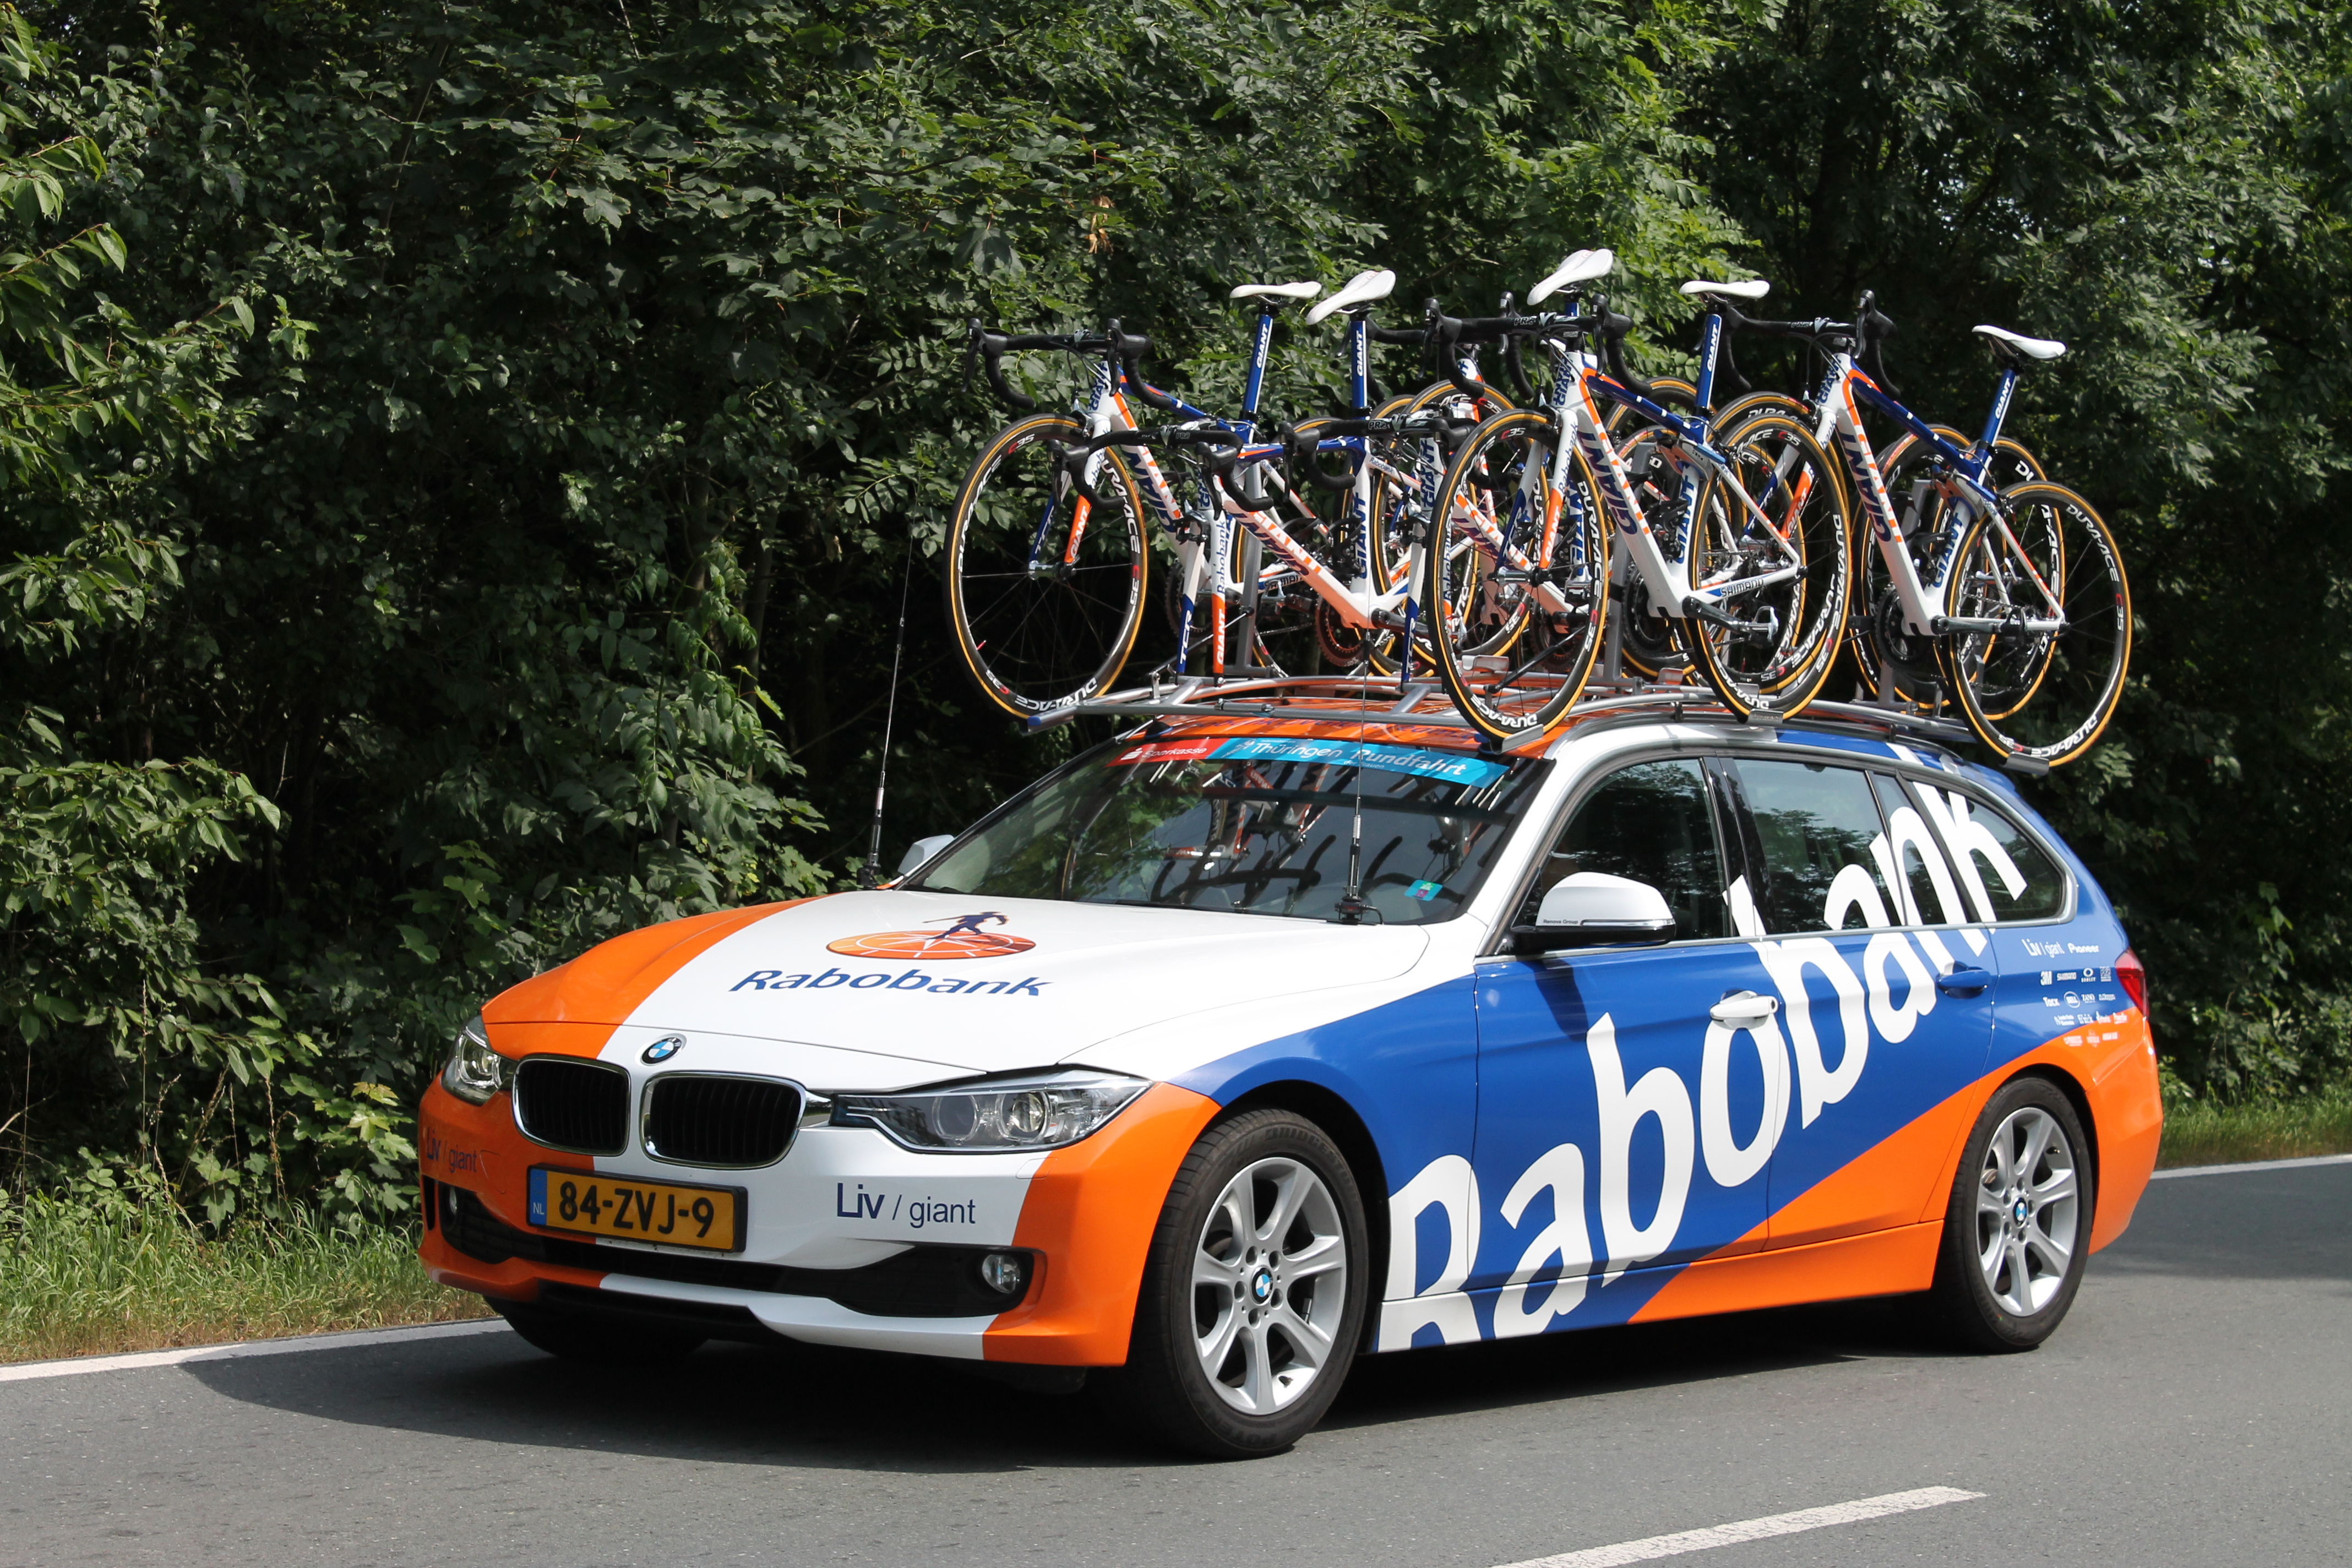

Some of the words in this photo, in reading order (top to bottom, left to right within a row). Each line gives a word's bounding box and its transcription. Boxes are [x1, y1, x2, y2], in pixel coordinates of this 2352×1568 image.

[1256, 324, 1268, 368] GIANT
[1356, 330, 1364, 377] GIANT
[1707, 324, 1718, 372] GIANT
[1995, 378, 2012, 420] GIANT
[1008, 433, 1035, 454] C35
[1501, 427, 1526, 439] C35
[1777, 431, 1801, 447] C35
[1070, 505, 1091, 558] GIANT
[1352, 492, 1368, 579] GIANT
[1545, 505, 1561, 563] GIANT
[1577, 480, 1602, 600] DURA-ACE
[1215, 520, 1226, 594] Rabobank
[1832, 514, 1847, 630] DURA-ACE
[2066, 503, 2120, 583] DURA-ACE
[2115, 593, 2124, 632] C35
[1129, 565, 1140, 606] C35
[1721, 578, 1764, 597] SHIMANO
[1179, 609, 1193, 664] TCR
[1216, 609, 1226, 665] GIANT
[1583, 609, 1599, 652] C35
[1815, 638, 1834, 673] C35
[986, 669, 1010, 695] C35
[1713, 654, 1770, 710] DURA-ACE
[1470, 694, 1539, 728] DURA-ACE
[1142, 746, 1207, 758] Sparkasse
[2031, 715, 2099, 758] DURA-ACE
[1250, 742, 1343, 758] Thüringen
[1350, 749, 1467, 775] Rundfahrt
[2046, 941, 2065, 957] giant
[2067, 942, 2099, 954] Pioneer
[728, 967, 1054, 997] Rabobank
[2040, 971, 2053, 986] 3M
[1376, 744, 2028, 1354] Rabobank
[448, 1144, 477, 1173] giant
[533, 1202, 545, 1215] NL
[558, 1180, 714, 1238] 84-ZVJ-9
[836, 1183, 886, 1219] Liv
[909, 1196, 976, 1229] giant
